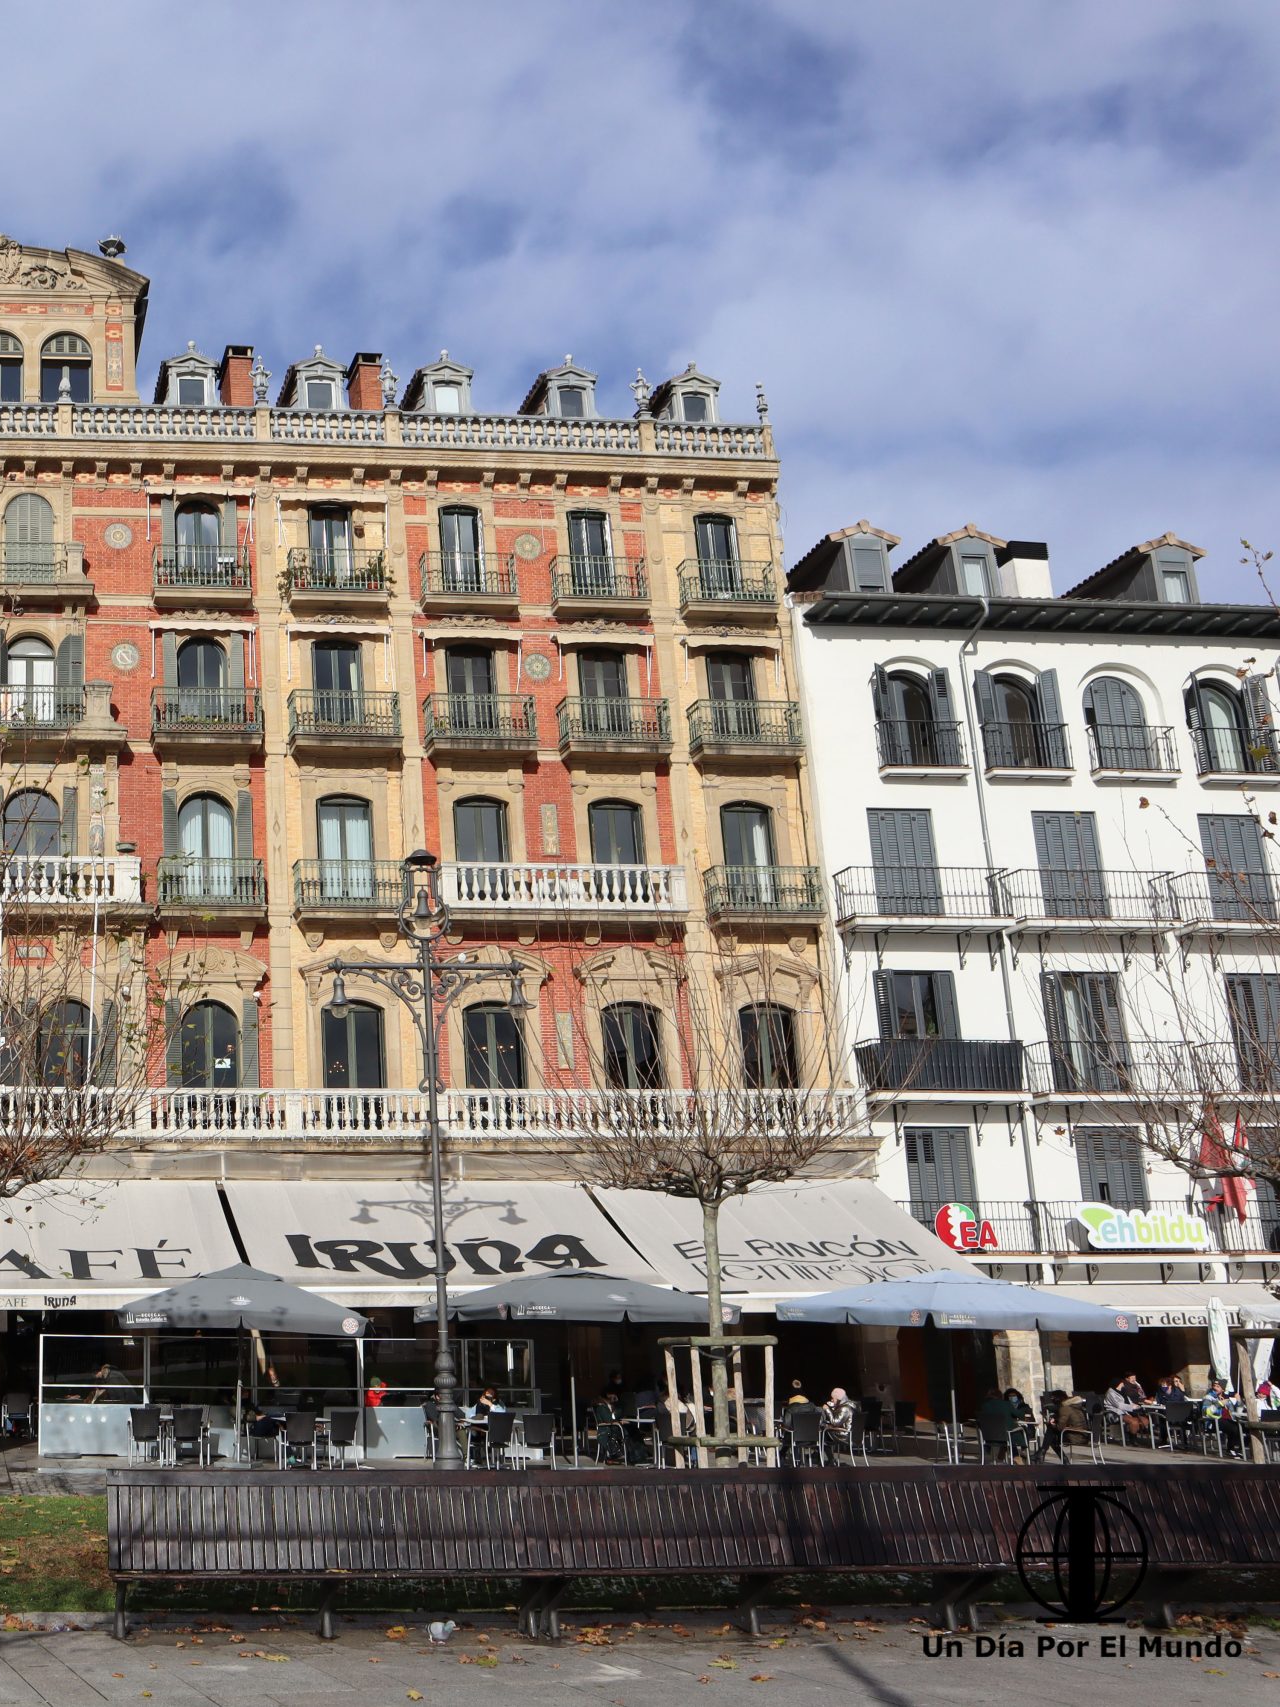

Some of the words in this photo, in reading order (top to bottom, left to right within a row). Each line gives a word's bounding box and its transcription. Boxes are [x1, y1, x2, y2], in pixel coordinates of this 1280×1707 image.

[960, 1221, 999, 1248] EA
[1101, 1214, 1205, 1244] ehbildu
[744, 1235, 920, 1258] RINCÓN
